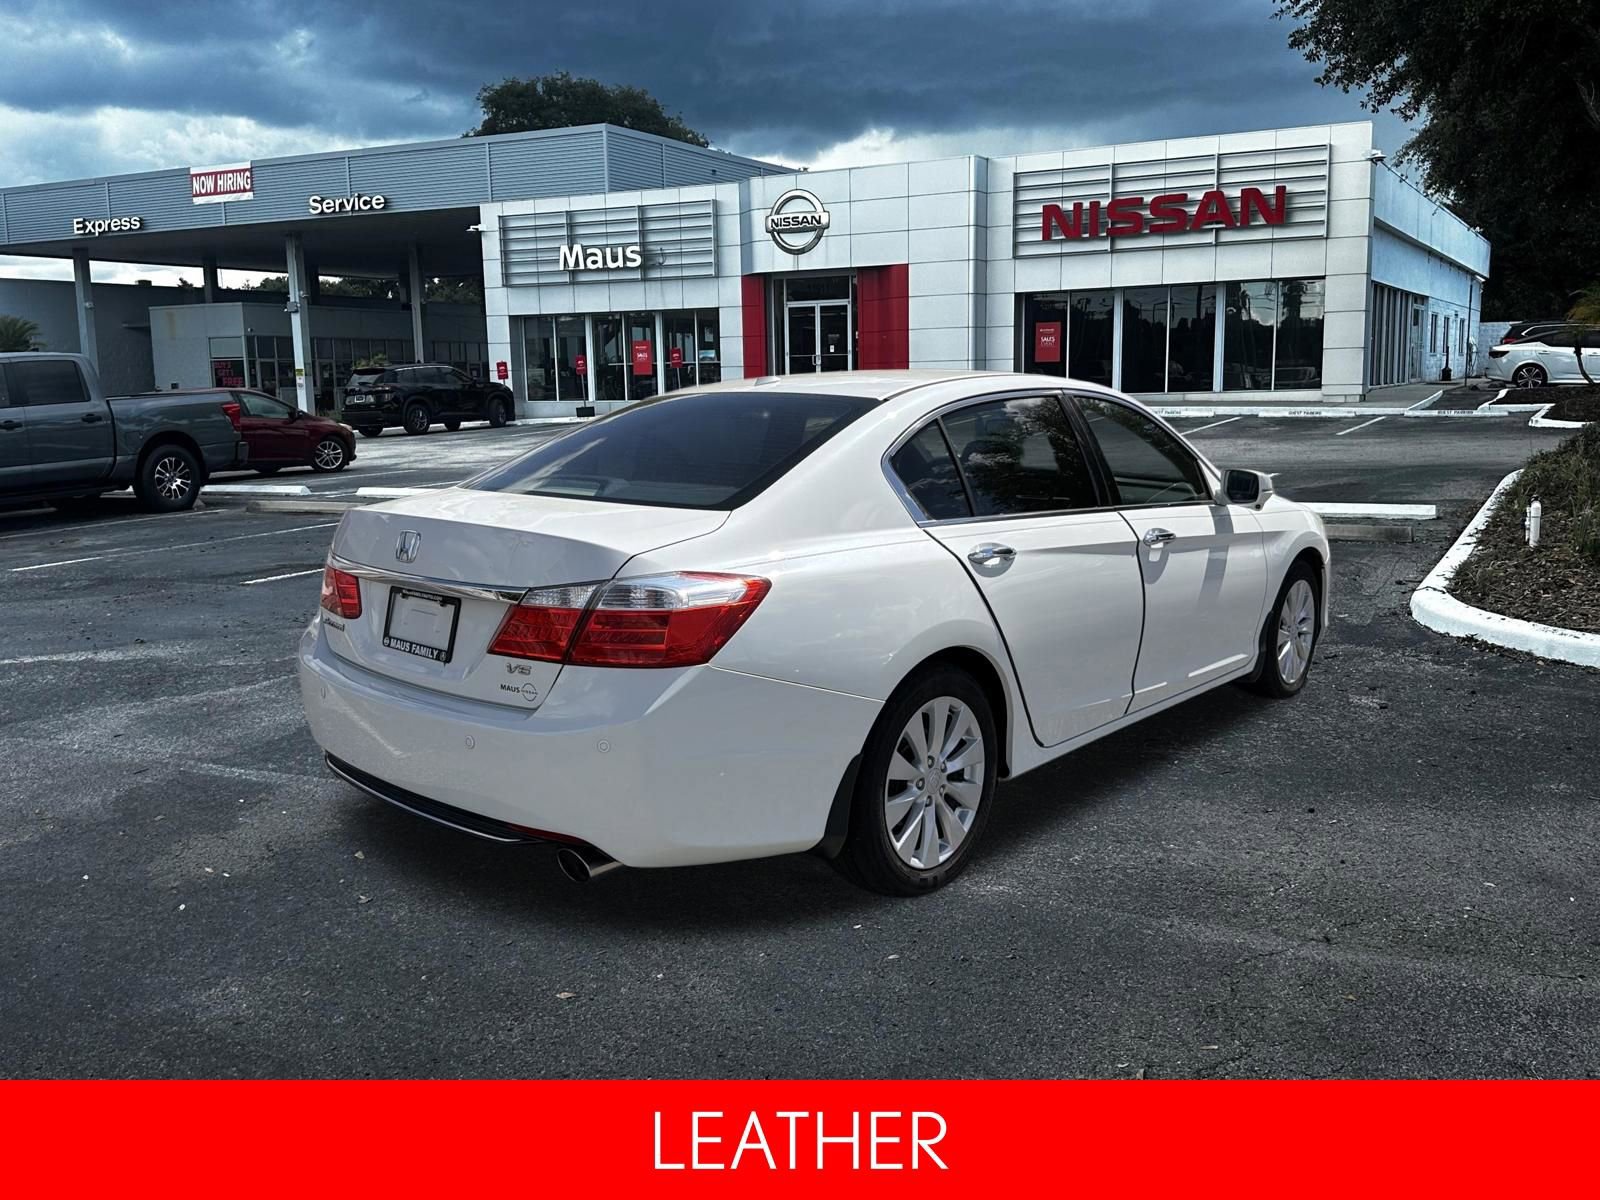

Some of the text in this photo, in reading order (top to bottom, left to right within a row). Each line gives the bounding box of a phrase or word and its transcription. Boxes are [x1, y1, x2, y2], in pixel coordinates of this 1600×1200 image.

[192, 171, 251, 195] NOW HIRING
[309, 193, 386, 215] Service
[1042, 185, 1287, 241] NISSAN
[73, 216, 141, 236] Express
[770, 214, 822, 229] NISSAN
[559, 244, 642, 271] Maus
[390, 638, 439, 659] MAUS FAMILY
[500, 683, 520, 694] MAUS
